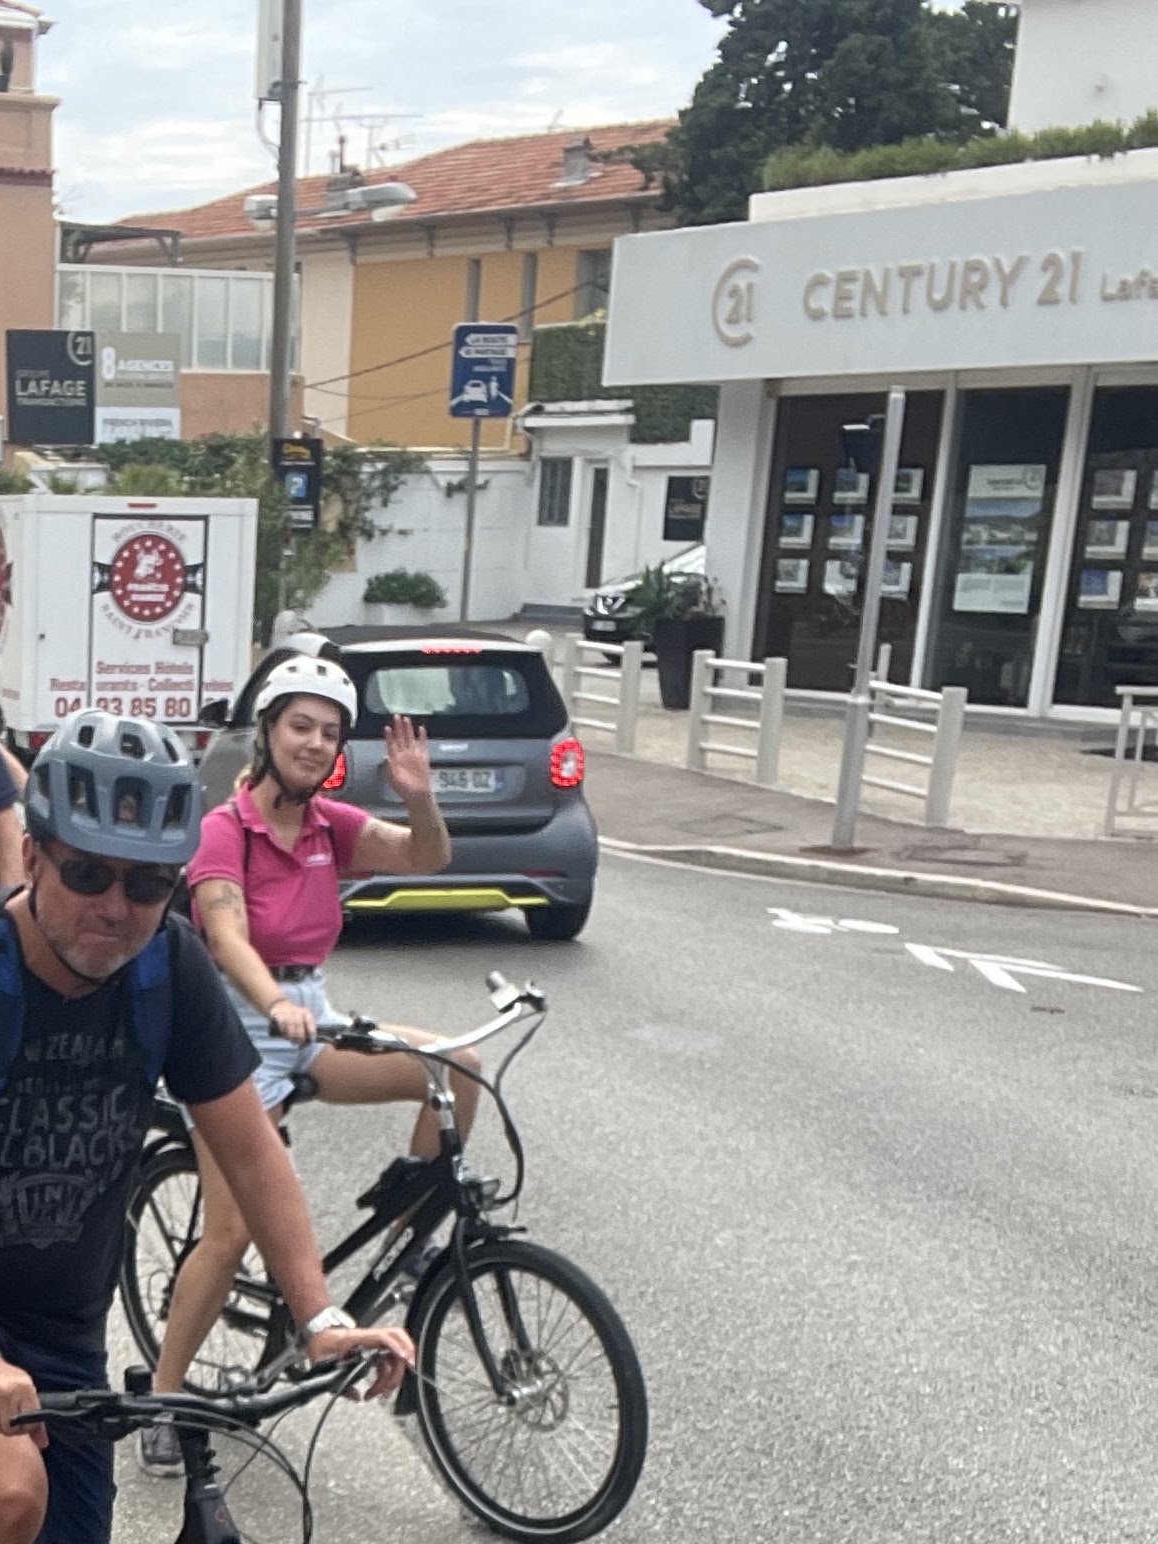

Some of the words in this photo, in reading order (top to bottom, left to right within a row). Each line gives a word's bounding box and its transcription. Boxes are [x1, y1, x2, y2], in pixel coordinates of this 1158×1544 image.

[802, 253, 1030, 321] CENTURY
[1037, 249, 1084, 305] 21
[14, 379, 87, 396] LAFAGE
[54, 696, 82, 718] 04
[130, 696, 157, 718] 85
[164, 696, 191, 718] 80
